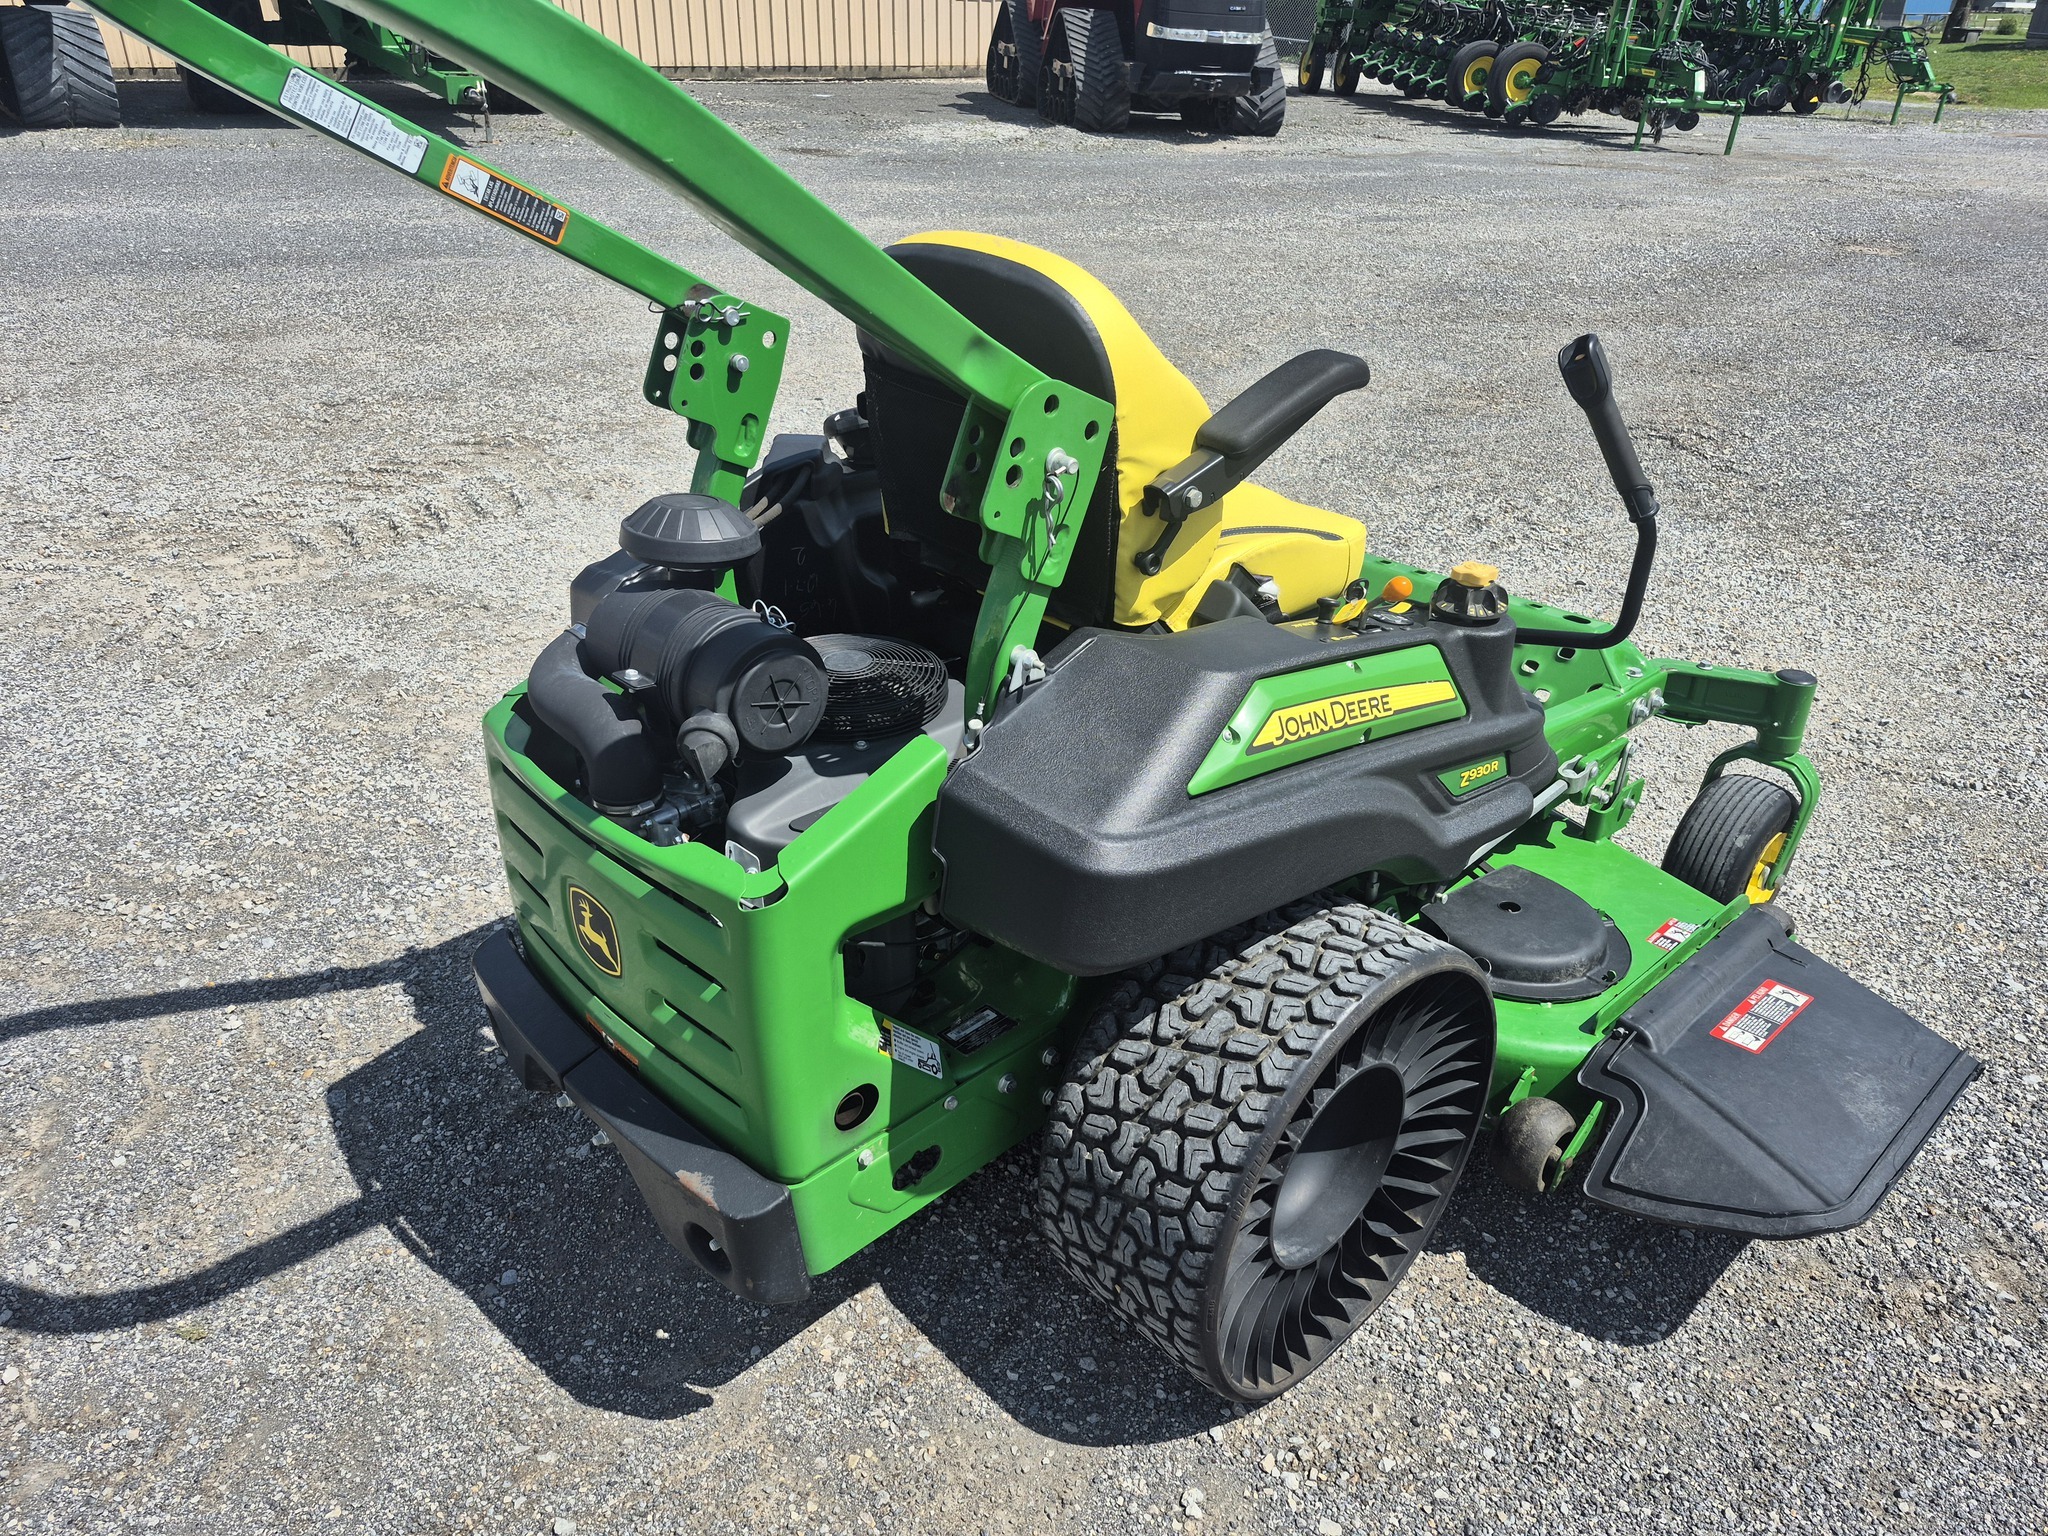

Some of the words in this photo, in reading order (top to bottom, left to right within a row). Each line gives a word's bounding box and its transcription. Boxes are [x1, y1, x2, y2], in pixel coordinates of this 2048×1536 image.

[1275, 708, 1329, 741] JOHN
[1329, 693, 1393, 725] DEERE
[1459, 760, 1500, 788] Z930R
[1753, 987, 1769, 1001] PELIGRO
[1724, 1012, 1742, 1027] DANGER
[1231, 1133, 1275, 1220] MICHELIN
